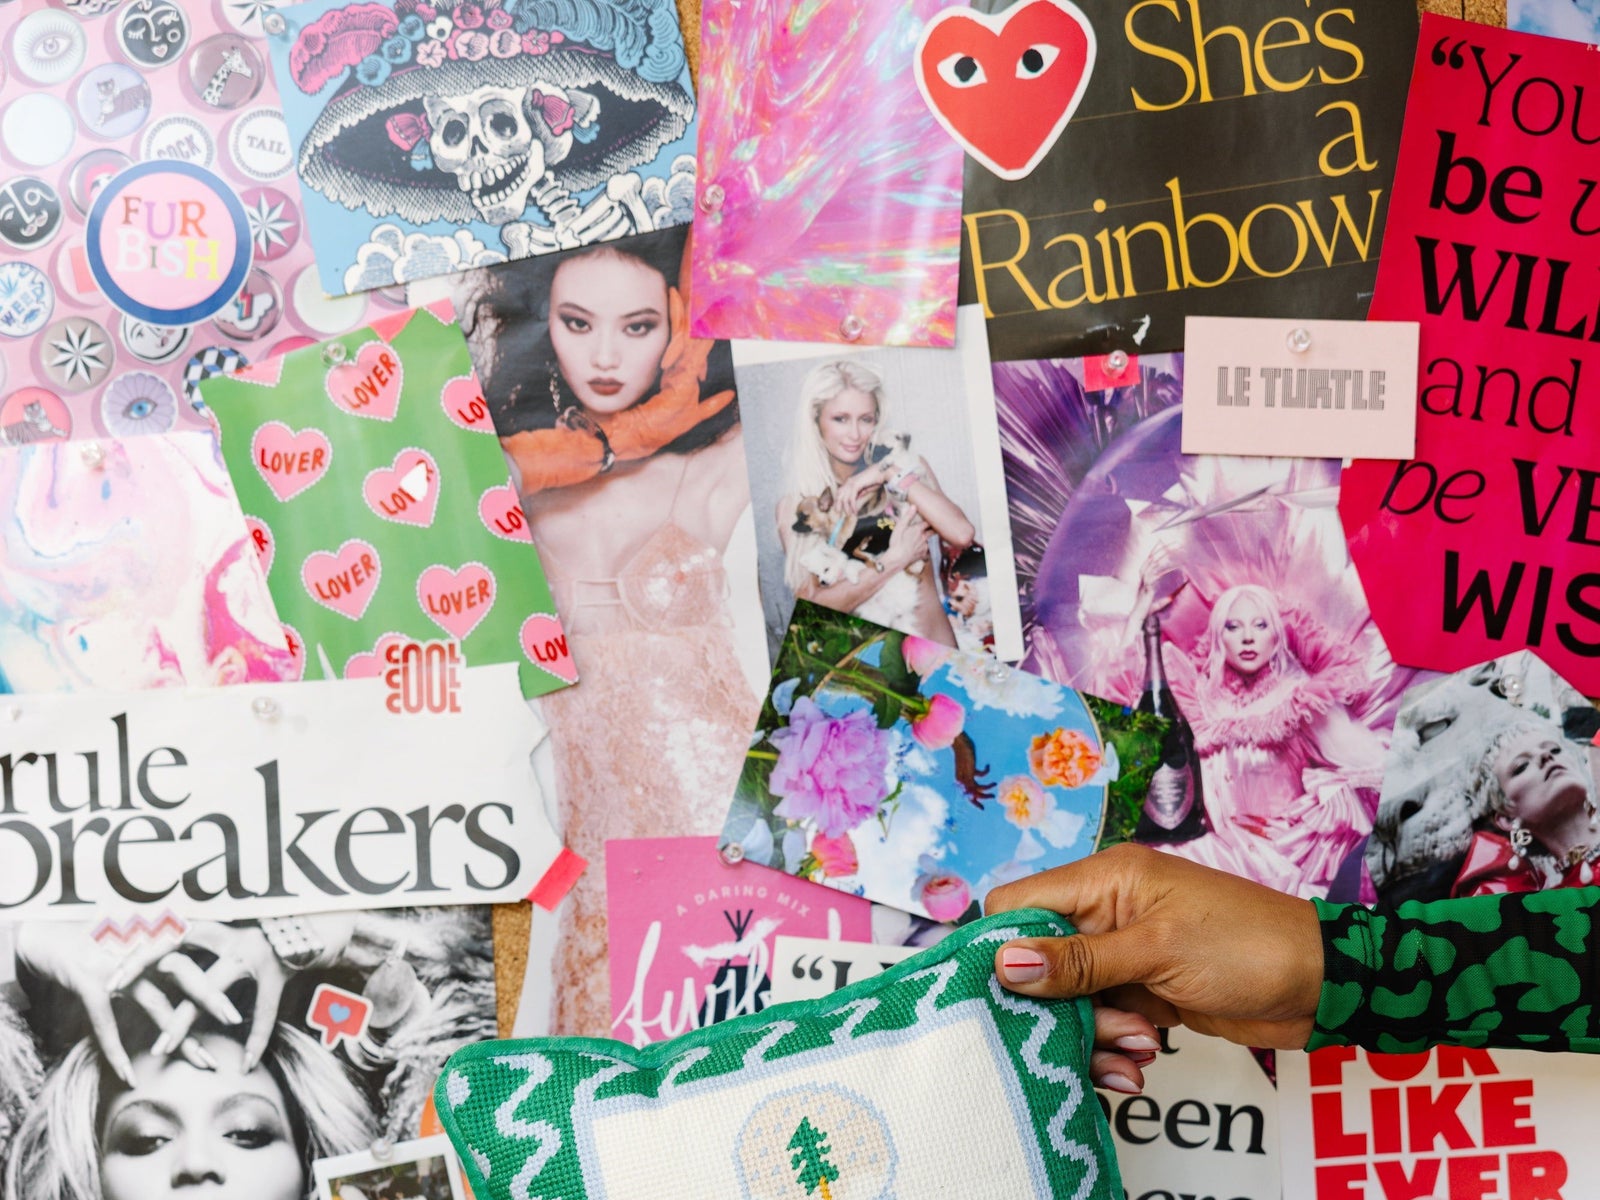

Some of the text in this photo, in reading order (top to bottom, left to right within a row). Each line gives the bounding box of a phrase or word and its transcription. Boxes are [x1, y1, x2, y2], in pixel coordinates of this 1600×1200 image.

[247, 135, 286, 155] TAIL
[1315, 101, 1378, 177] a
[1429, 129, 1543, 225] be
[122, 196, 208, 240] FUR
[962, 177, 1382, 319] Rainbow
[1415, 234, 1600, 342] WIL
[342, 352, 397, 410] LOVER
[1216, 366, 1386, 411] LE TURTLE
[1420, 357, 1581, 437] and
[260, 447, 325, 475] LOVER
[315, 553, 376, 601] LOVER
[427, 578, 491, 616] LOVER
[0, 712, 192, 814] rule
[694, 885, 768, 906] DARING
[776, 892, 810, 917] MIX
[1311, 1079, 1536, 1159] LIKE
